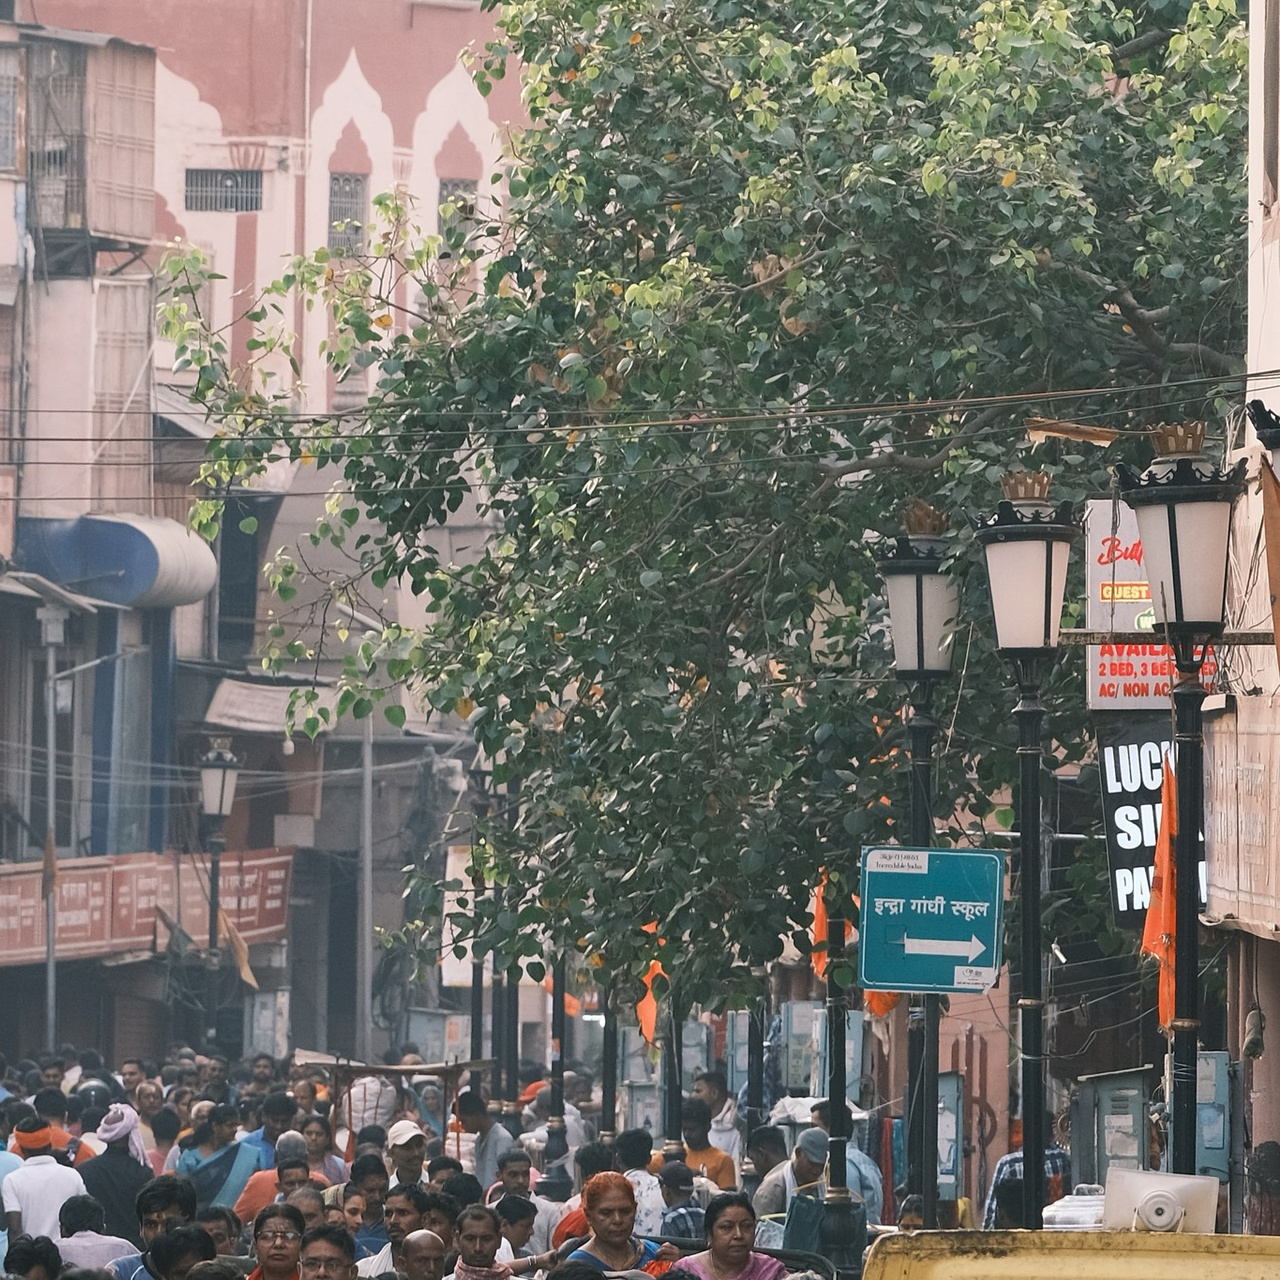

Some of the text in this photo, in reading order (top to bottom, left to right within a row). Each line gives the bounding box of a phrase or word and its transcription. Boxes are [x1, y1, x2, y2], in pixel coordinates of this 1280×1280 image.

[1102, 583, 1149, 600] GUEST
[1099, 662, 1107, 676] 2
[1141, 662, 1148, 676] 3
[1123, 682, 1149, 697] NON
[950, 900, 990, 922] स्कूल
